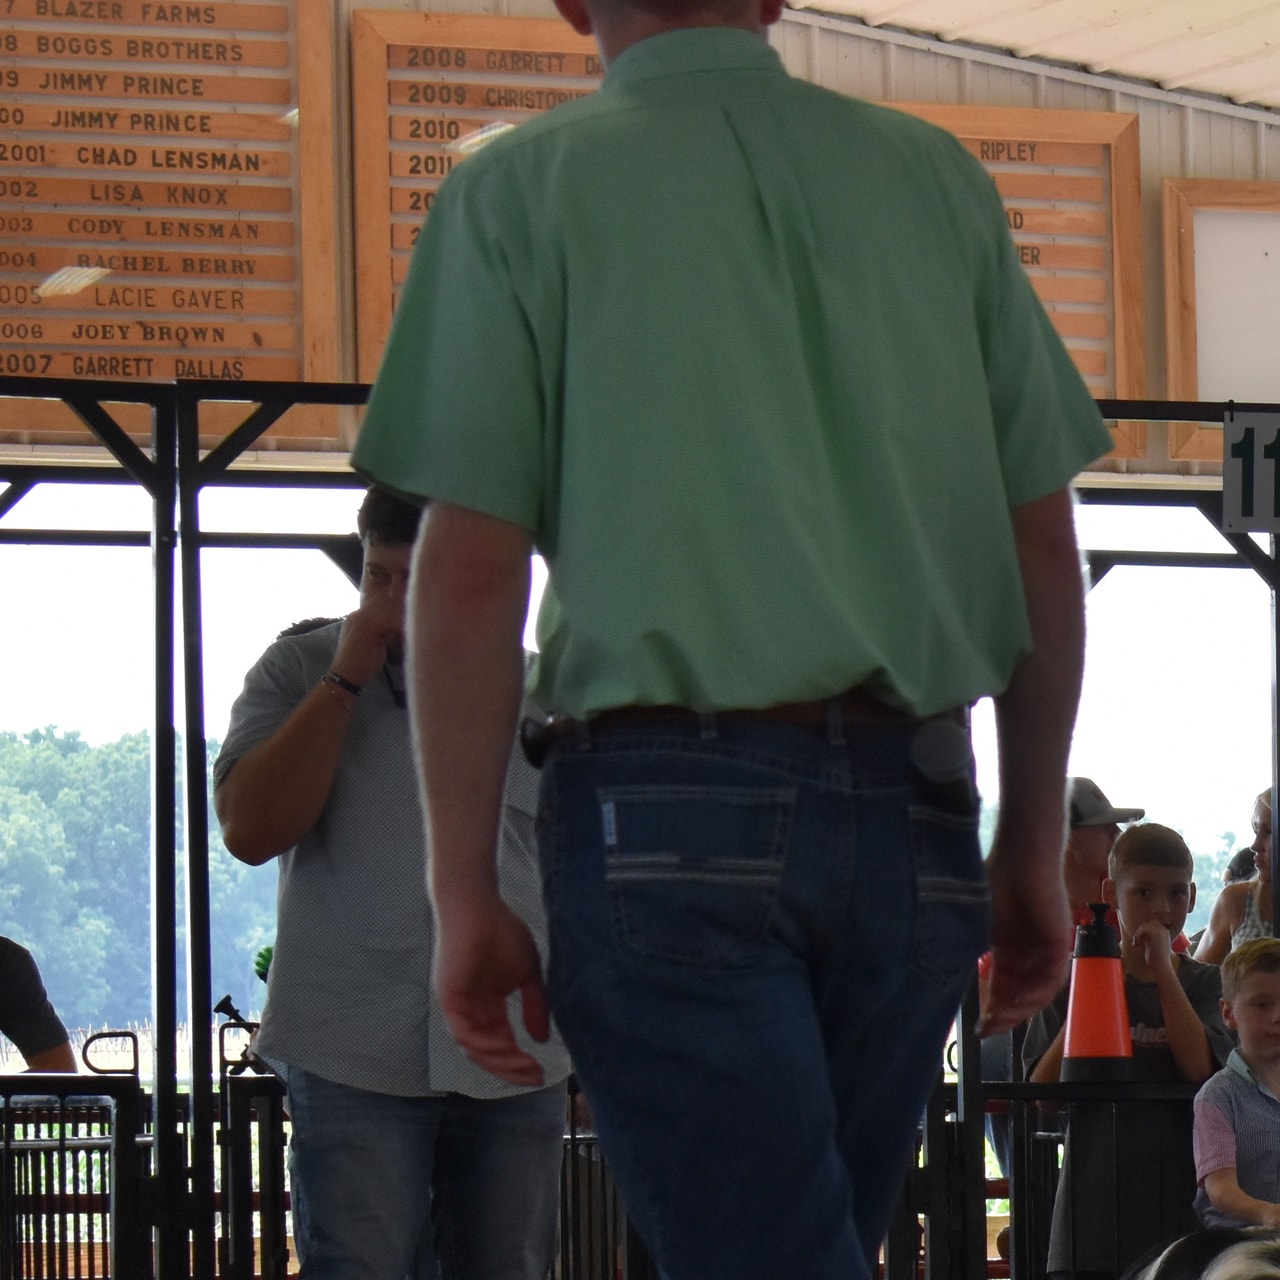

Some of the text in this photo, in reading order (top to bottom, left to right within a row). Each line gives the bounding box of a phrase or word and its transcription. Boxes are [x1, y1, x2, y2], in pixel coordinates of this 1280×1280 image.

[36, 0, 123, 20] BLAZER
[142, 6, 216, 24] FARMS
[37, 36, 113, 56] BOGGS
[126, 40, 243, 61] BROTHERS
[407, 48, 466, 68] 2008
[486, 52, 565, 73] GARRETT
[38, 72, 108, 93] JIMMY
[123, 76, 204, 96] PRINCE
[408, 85, 467, 105] 2009
[51, 110, 118, 129] JIMMY
[130, 114, 211, 133] PRINCE
[409, 119, 460, 139] 2010
[0, 143, 259, 171] 2001 CHAD LENSMAN
[980, 141, 1036, 161] RIPLEY
[409, 155, 452, 175] 2011
[91, 184, 144, 202] LISA
[167, 186, 228, 205] KNOX
[68, 218, 124, 236] CODY
[146, 221, 259, 239] LENSMAN
[77, 254, 170, 272] RACHEL
[182, 257, 256, 275] BERRY
[95, 287, 156, 308] LACIE
[173, 289, 244, 310] GAVER
[72, 324, 130, 341] JOEY
[142, 325, 225, 342] BROWN
[0, 354, 243, 379] 007 GARRETT DALLAS
